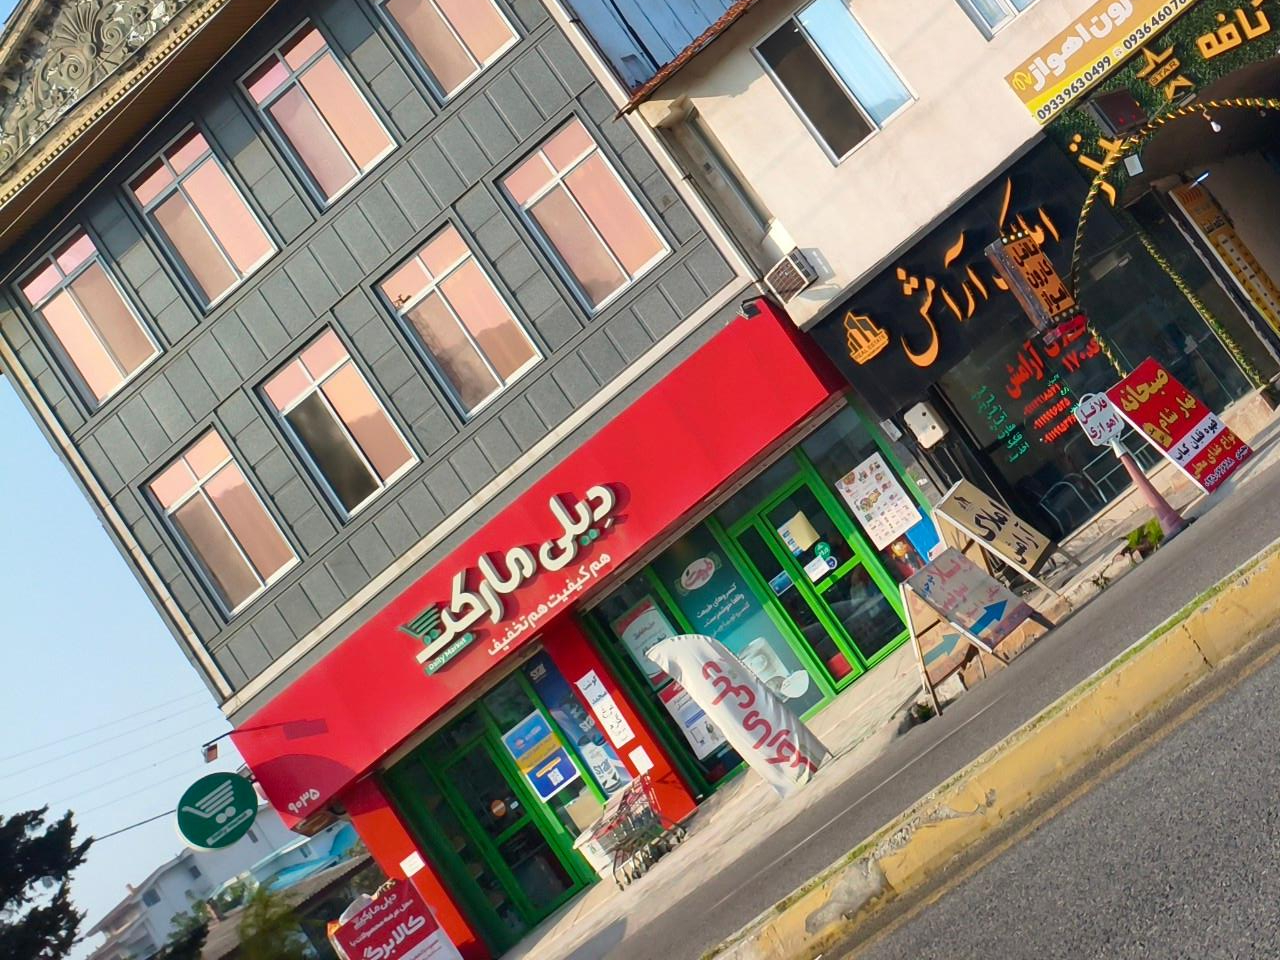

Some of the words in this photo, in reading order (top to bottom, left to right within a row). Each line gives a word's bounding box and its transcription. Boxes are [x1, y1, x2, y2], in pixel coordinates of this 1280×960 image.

[1025, 23, 1092, 92] اهواز
[1035, 92, 1066, 121] 0933
[1061, 75, 1087, 100] 963
[1082, 55, 1113, 84] 0499
[1121, 21, 1152, 51] 0936
[1148, 4, 1174, 29] 460
[1149, 59, 1179, 85] STAR
[1024, 259, 1058, 292] کارون
[895, 230, 990, 367] آرامش
[1040, 280, 1072, 316] اهواز
[1118, 366, 1169, 413] صبحانه
[1088, 413, 1119, 441] اهوازی
[1158, 407, 1178, 434] شام
[1202, 417, 1219, 438] قهوه
[1173, 442, 1191, 463] کباب
[1188, 429, 1206, 450] قلیان
[974, 499, 1009, 540] املاک
[588, 551, 612, 577] هم
[396, 544, 539, 665] مارکت
[544, 568, 592, 610] کیفیت
[526, 603, 549, 629] هم
[426, 653, 447, 672] Daily
[442, 636, 468, 659] Market
[485, 616, 531, 658] تخفیف
